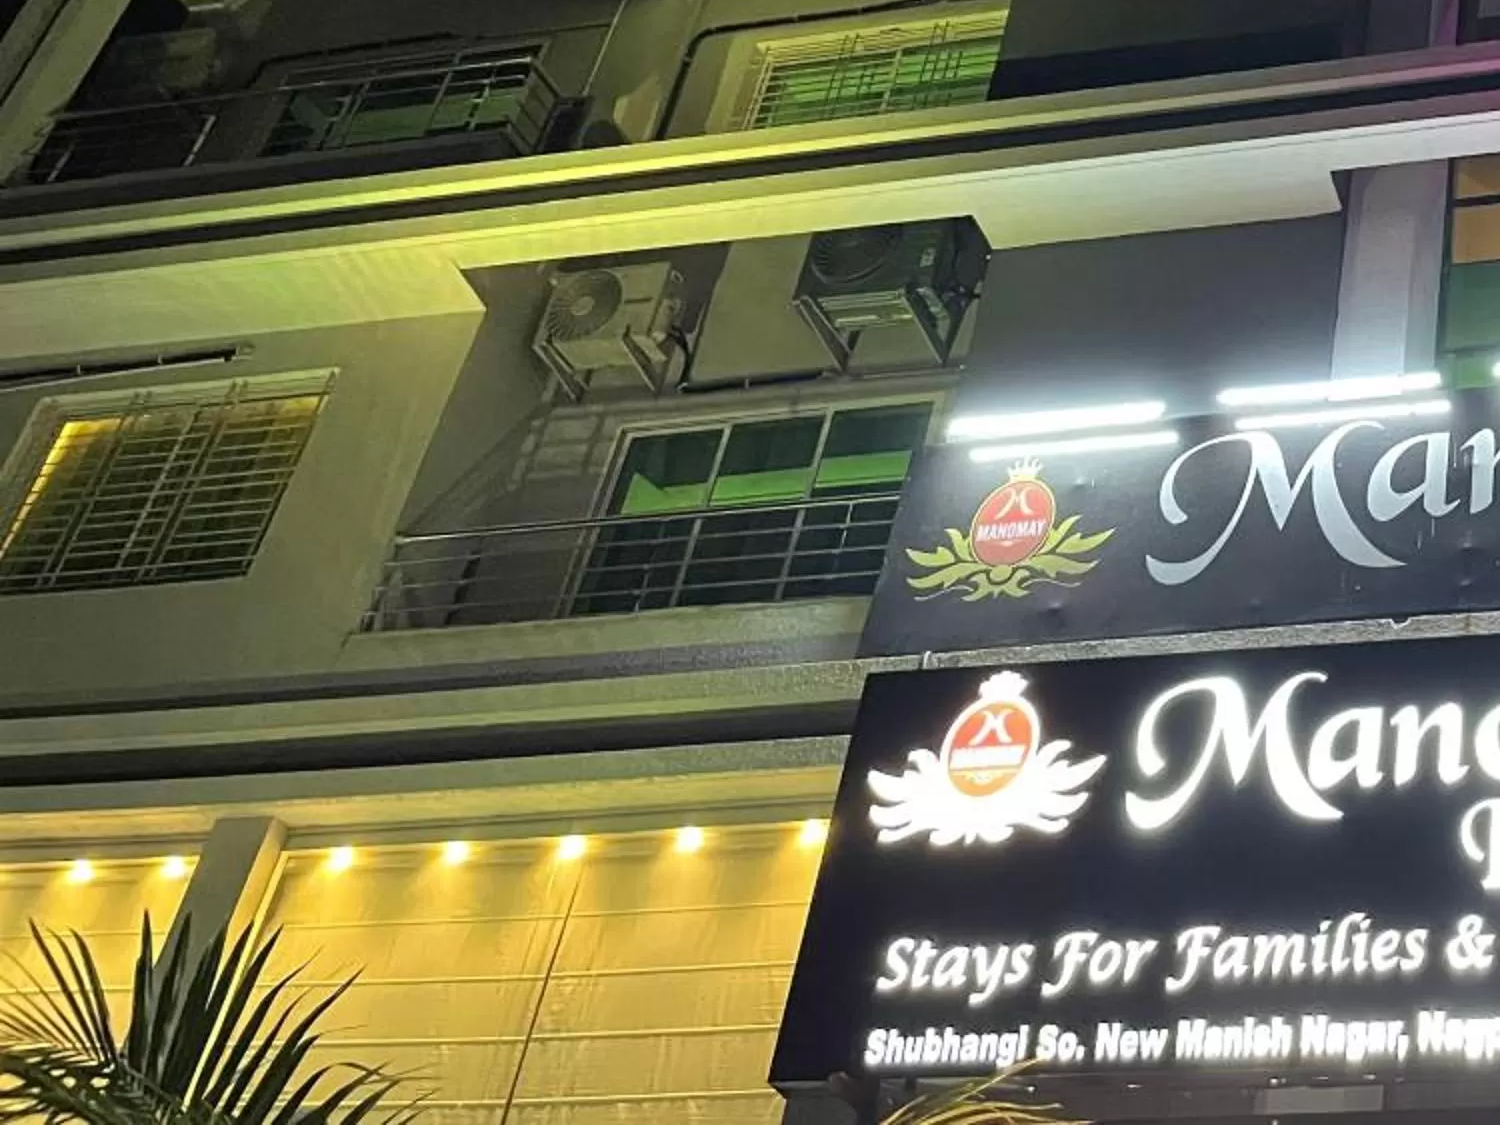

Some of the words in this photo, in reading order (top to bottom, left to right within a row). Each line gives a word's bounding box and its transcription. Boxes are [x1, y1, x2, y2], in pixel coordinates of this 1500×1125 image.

[976, 518, 1047, 542] MANOMAY
[876, 936, 1035, 1005] Stays
[1041, 930, 1159, 998] For
[1165, 911, 1429, 993] Families
[1444, 913, 1497, 972] &
[1035, 1023, 1085, 1062] So.
[1094, 1021, 1169, 1061] New
[1175, 1015, 1294, 1061] Manish
